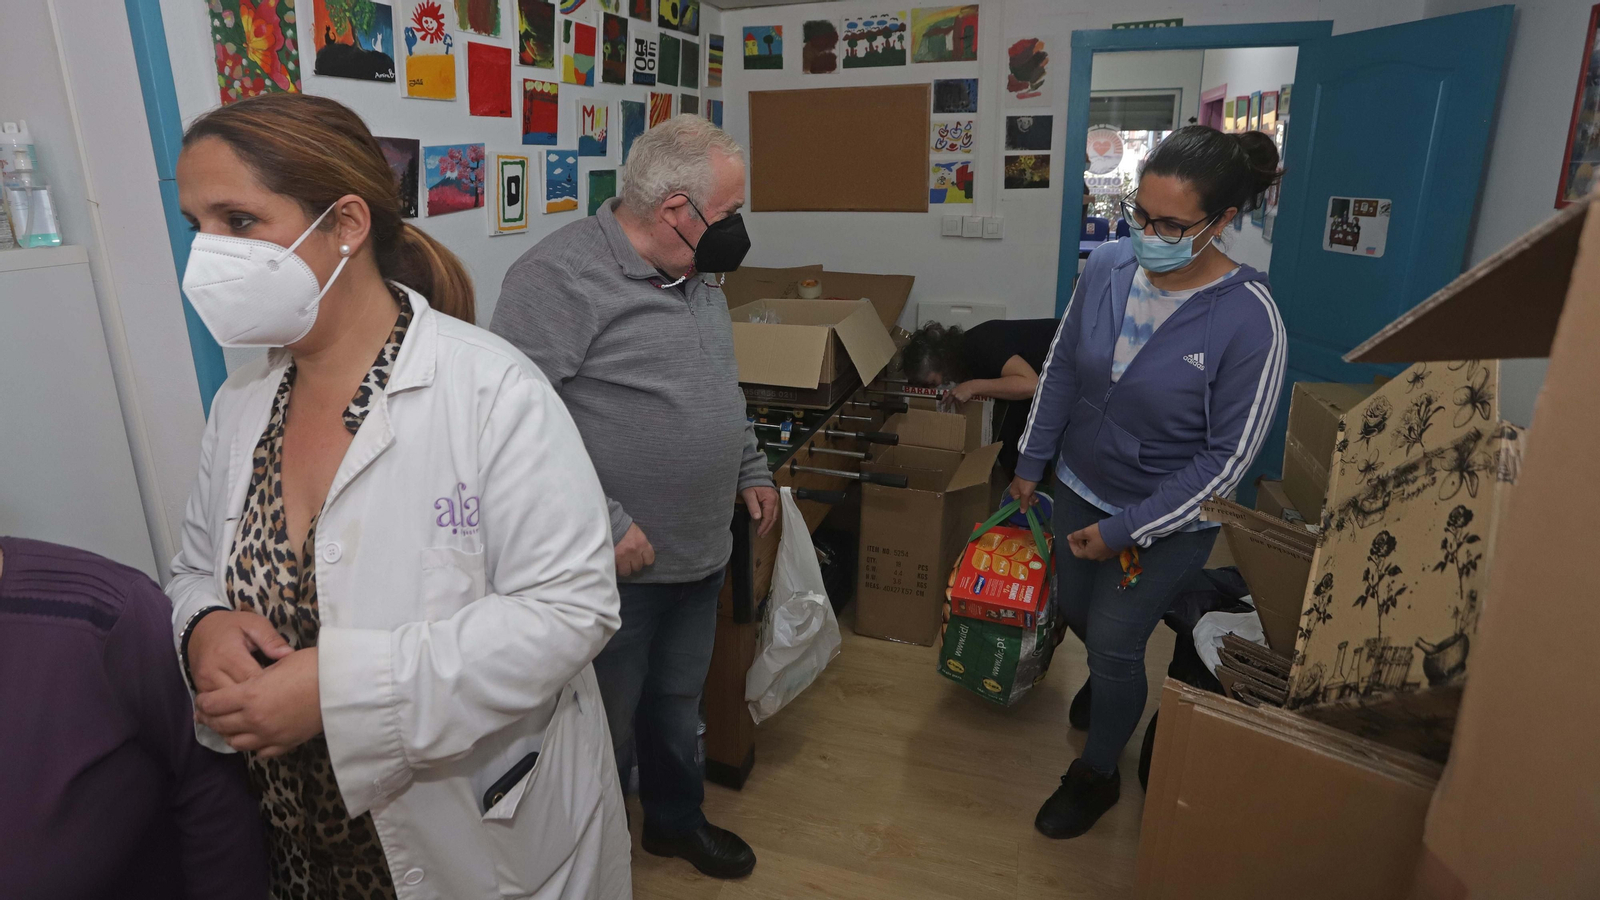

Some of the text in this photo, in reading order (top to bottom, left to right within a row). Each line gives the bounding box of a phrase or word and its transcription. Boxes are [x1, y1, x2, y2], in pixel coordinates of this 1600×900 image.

[866, 545, 880, 553] ITEM
[917, 564, 929, 572] PCS
[917, 572, 928, 581] KGS
[916, 581, 928, 589] KGS
